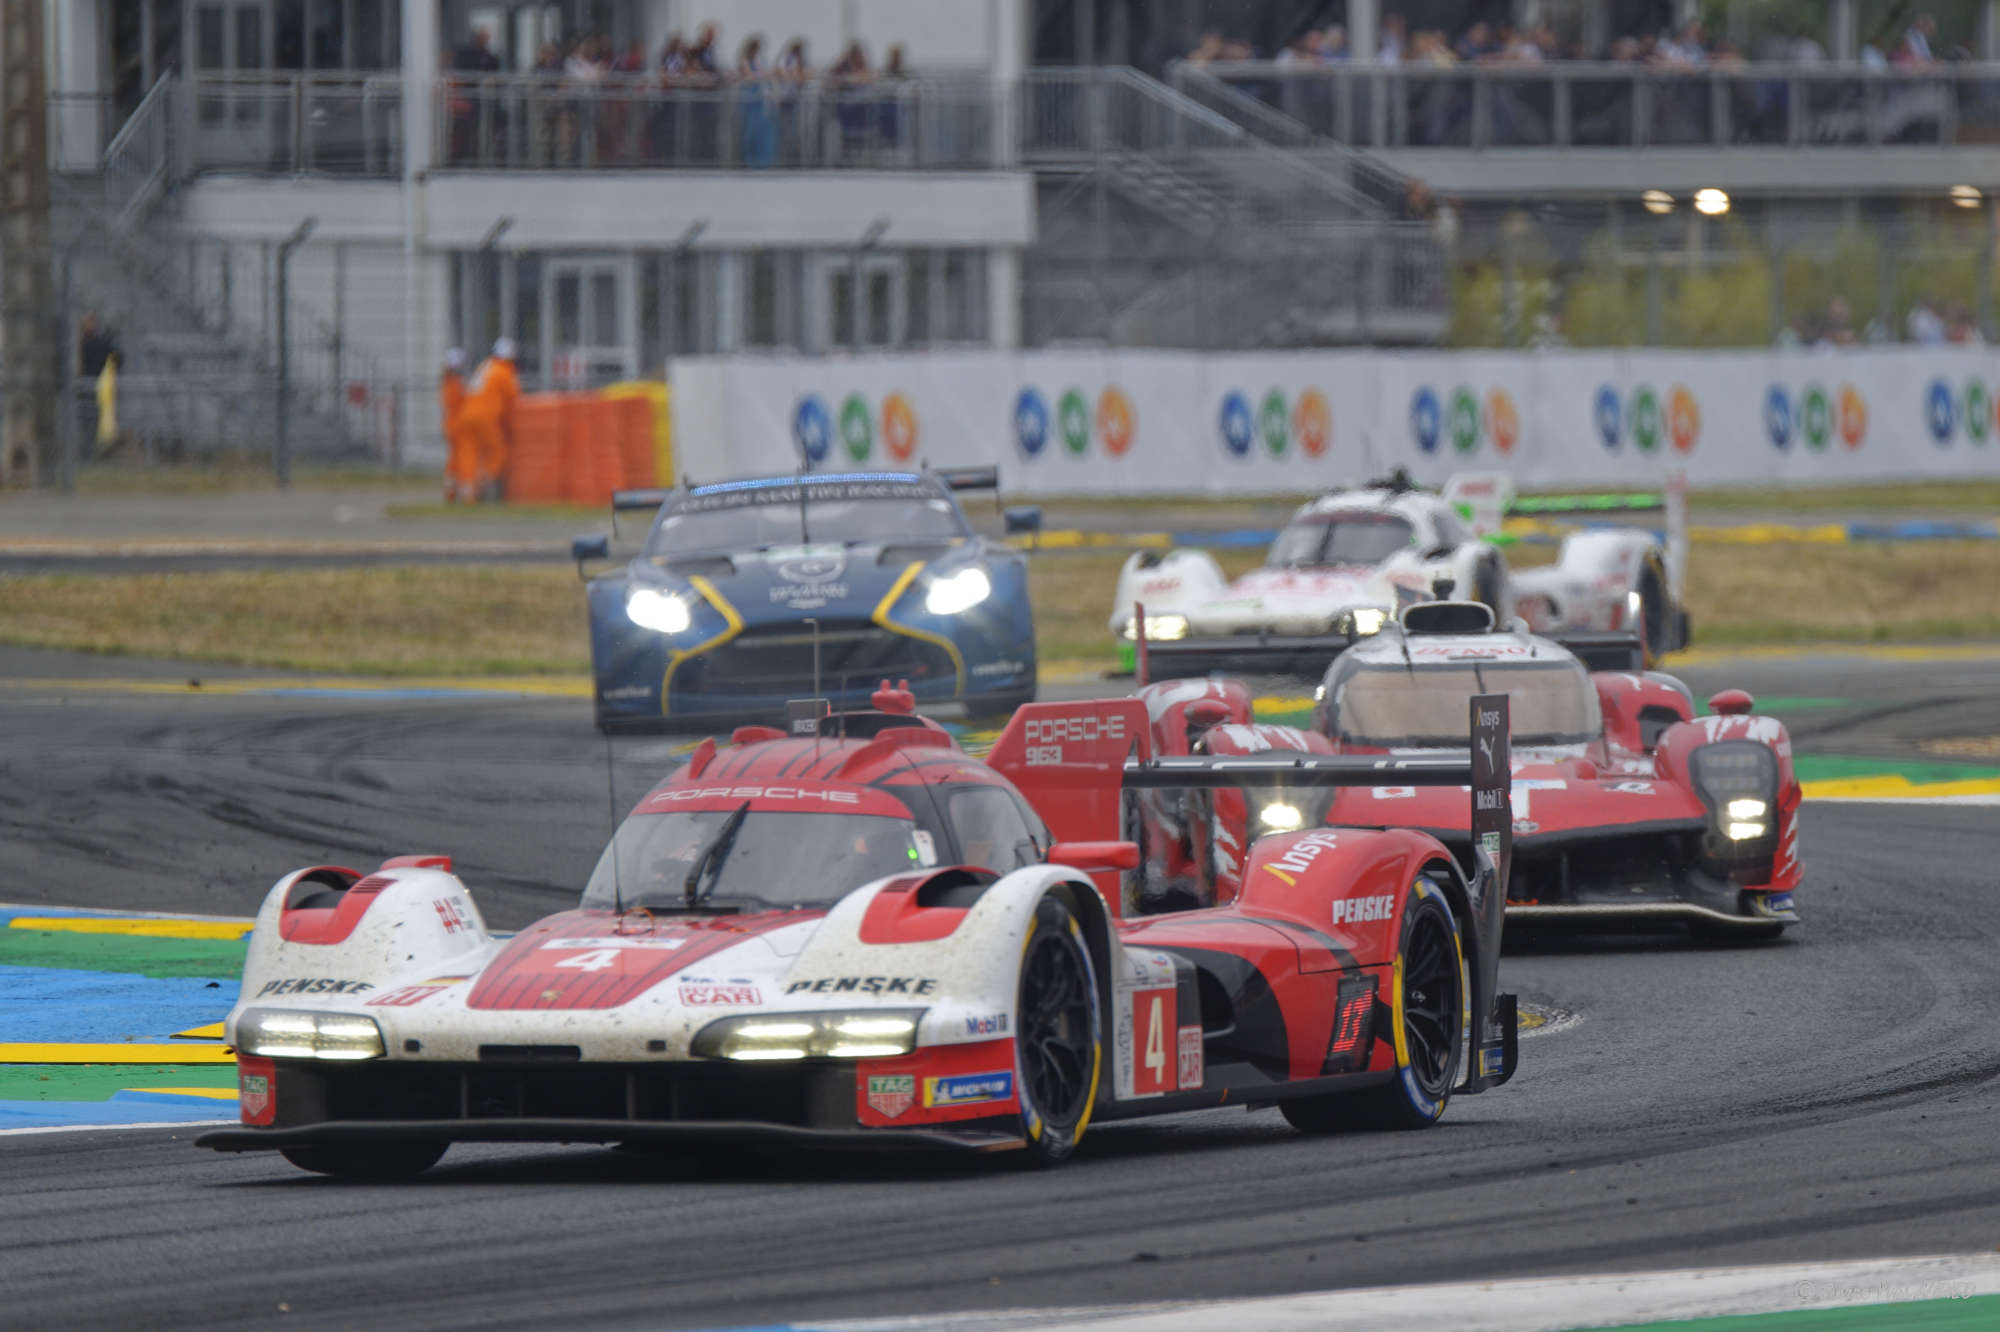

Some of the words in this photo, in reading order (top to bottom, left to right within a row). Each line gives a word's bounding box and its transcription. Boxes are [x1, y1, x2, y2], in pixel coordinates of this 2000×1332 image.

[1475, 705, 1500, 730] Ansys
[1025, 715, 1125, 744] PORSCHE
[1026, 746, 1062, 767] 963
[651, 787, 859, 804] PORSCHE
[1477, 789, 1496, 809] Mobil
[1262, 832, 1337, 887] Ansys
[1333, 895, 1395, 924] PENSKE
[554, 949, 622, 971] 4
[256, 978, 376, 998] PENSKE
[784, 976, 937, 995] PENSKE
[687, 993, 755, 1004] CAR
[966, 1014, 997, 1034] Mobil
[1145, 997, 1166, 1084] 4
[1180, 1052, 1201, 1083] CAR
[872, 1079, 911, 1091] TAG
[951, 1080, 1006, 1095] MICHELIN
